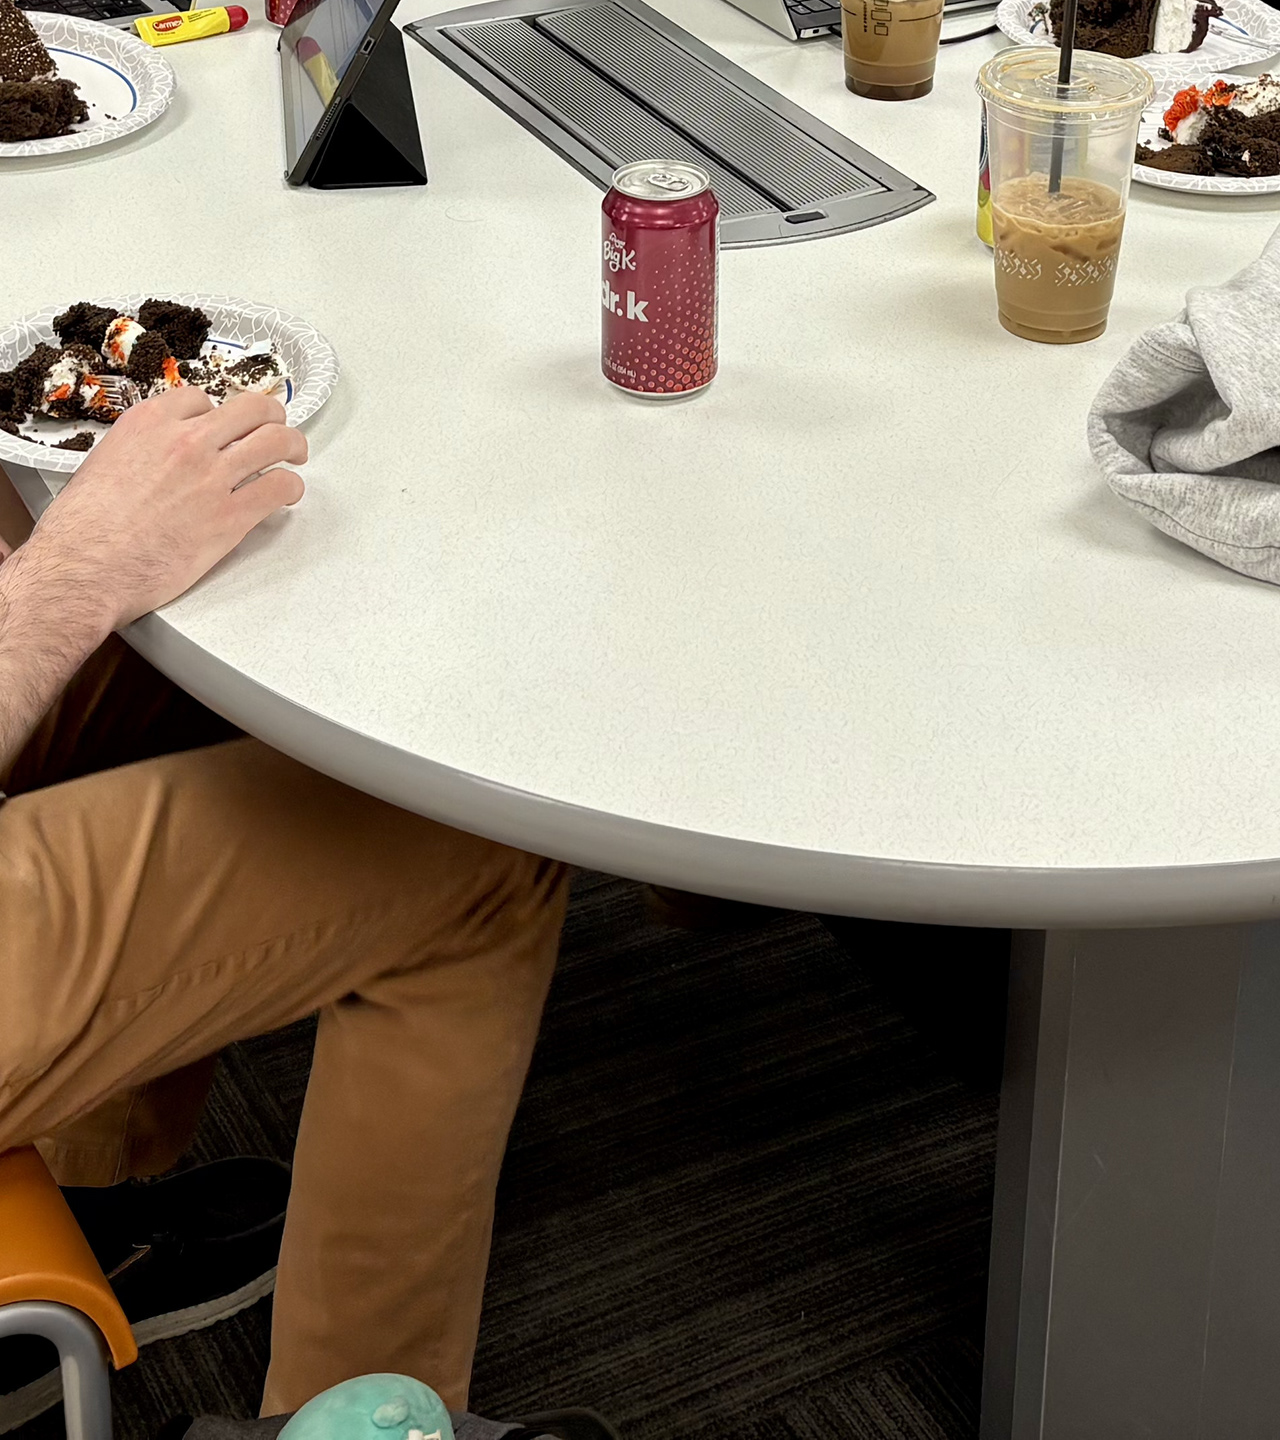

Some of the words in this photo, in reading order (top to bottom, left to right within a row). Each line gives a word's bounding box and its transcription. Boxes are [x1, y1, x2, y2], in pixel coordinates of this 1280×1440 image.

[152, 17, 184, 30] Carmex
[603, 240, 621, 272] Big
[601, 278, 624, 317] dr.
[626, 290, 649, 323] k
